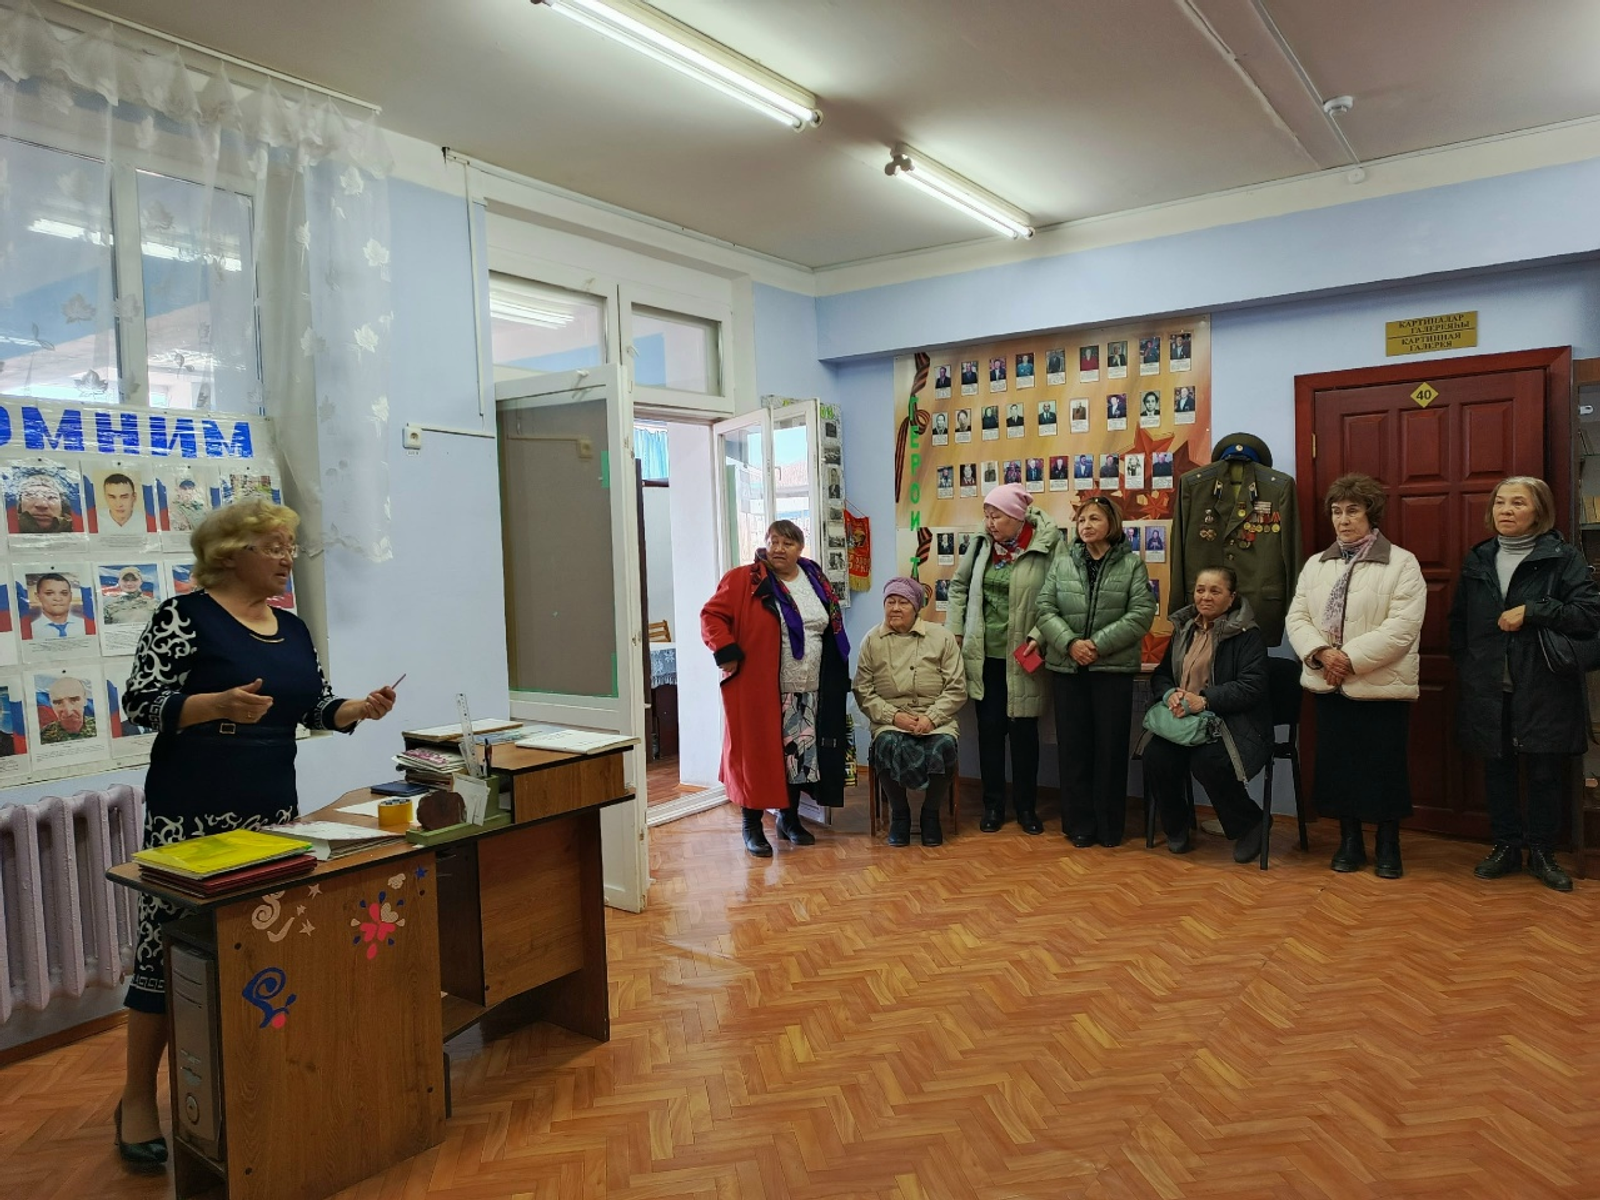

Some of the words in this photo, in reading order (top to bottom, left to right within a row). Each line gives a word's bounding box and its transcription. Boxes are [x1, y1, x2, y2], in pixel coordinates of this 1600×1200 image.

[1399, 313, 1464, 329] КАРТИНАЛАР
[1401, 332, 1461, 345] КАРТИННАЯ
[1409, 341, 1453, 352] ГАЛЕРЕЯ
[1416, 390, 1432, 400] 40
[0, 405, 254, 459] МНИМ
